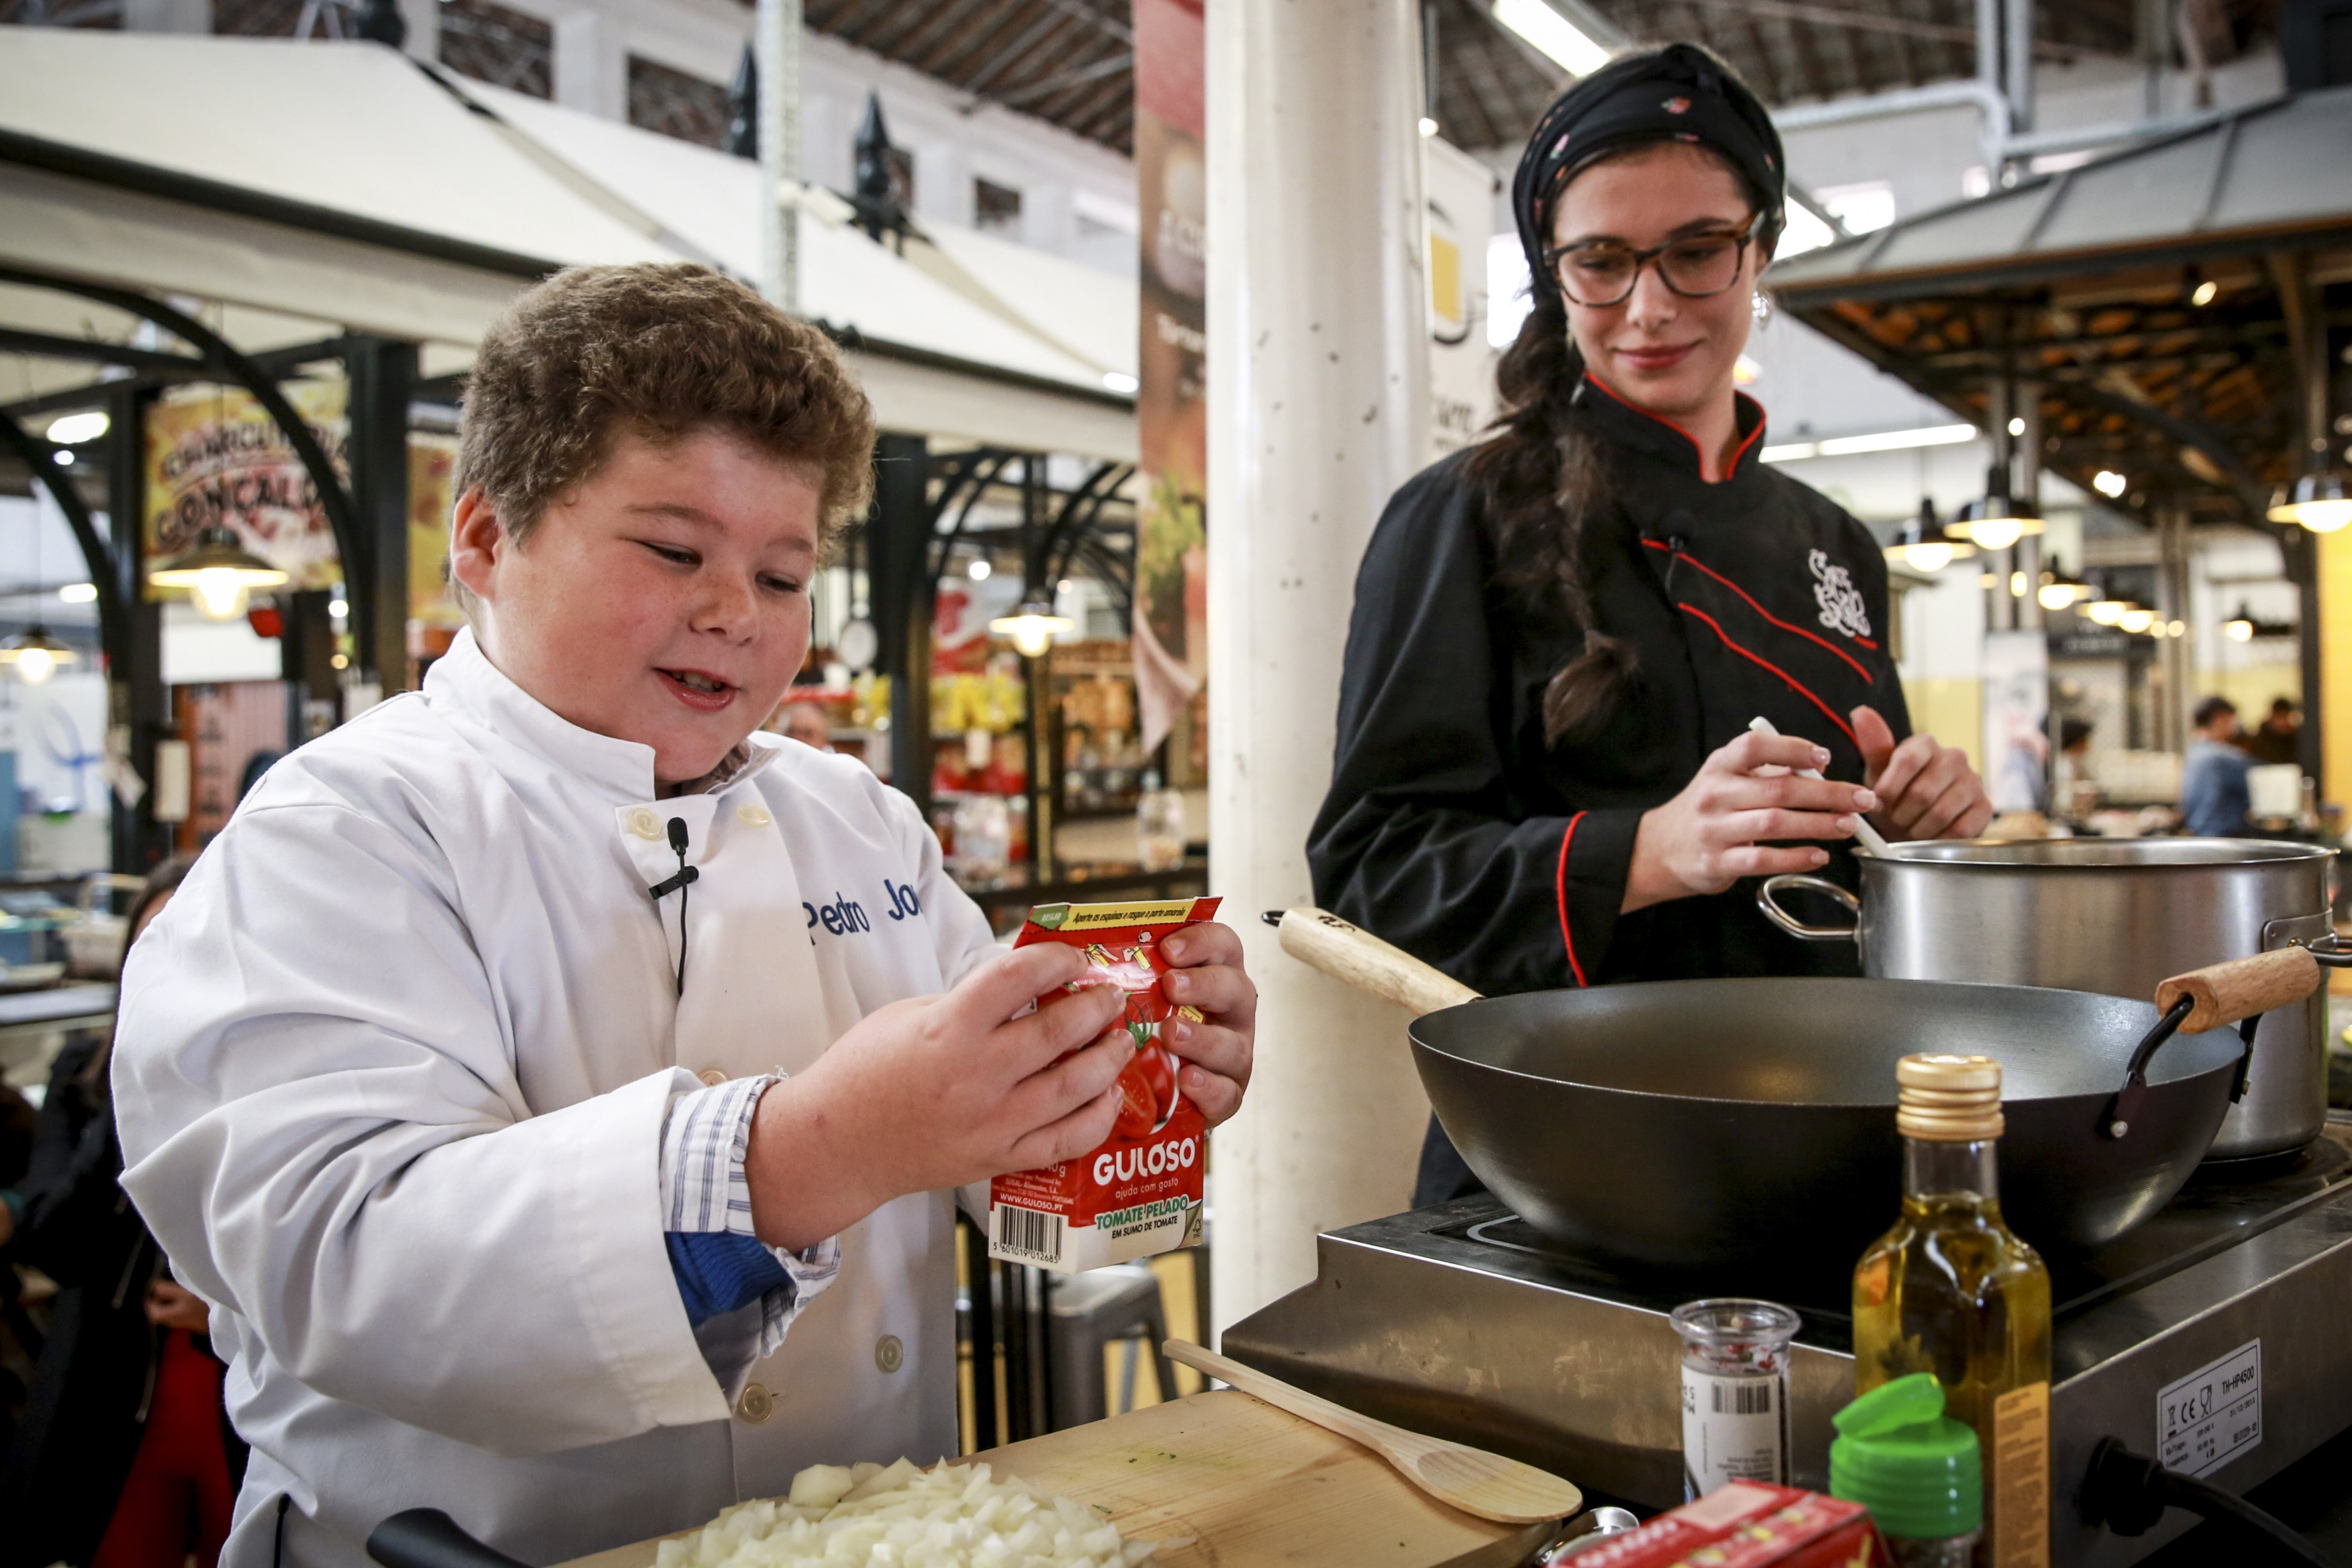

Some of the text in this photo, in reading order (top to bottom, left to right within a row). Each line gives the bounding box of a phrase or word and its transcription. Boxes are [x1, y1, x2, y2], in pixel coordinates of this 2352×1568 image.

[802, 879, 922, 946] Pedro Jo
[1148, 909, 1165, 919] parte
[1093, 1137, 1196, 1186] GULOSO
[1115, 1178, 1178, 1200] ajuda com gosto
[1000, 1193, 1063, 1211] WWW.GULOSO.PT
[1096, 1195, 1189, 1230] TOMATE PELADO
[1112, 1215, 1178, 1239] EM SUMO DE TOMATE
[993, 1242, 1058, 1264] 5 601019 012685
[2222, 1365, 2254, 1395] TH-HP4500
